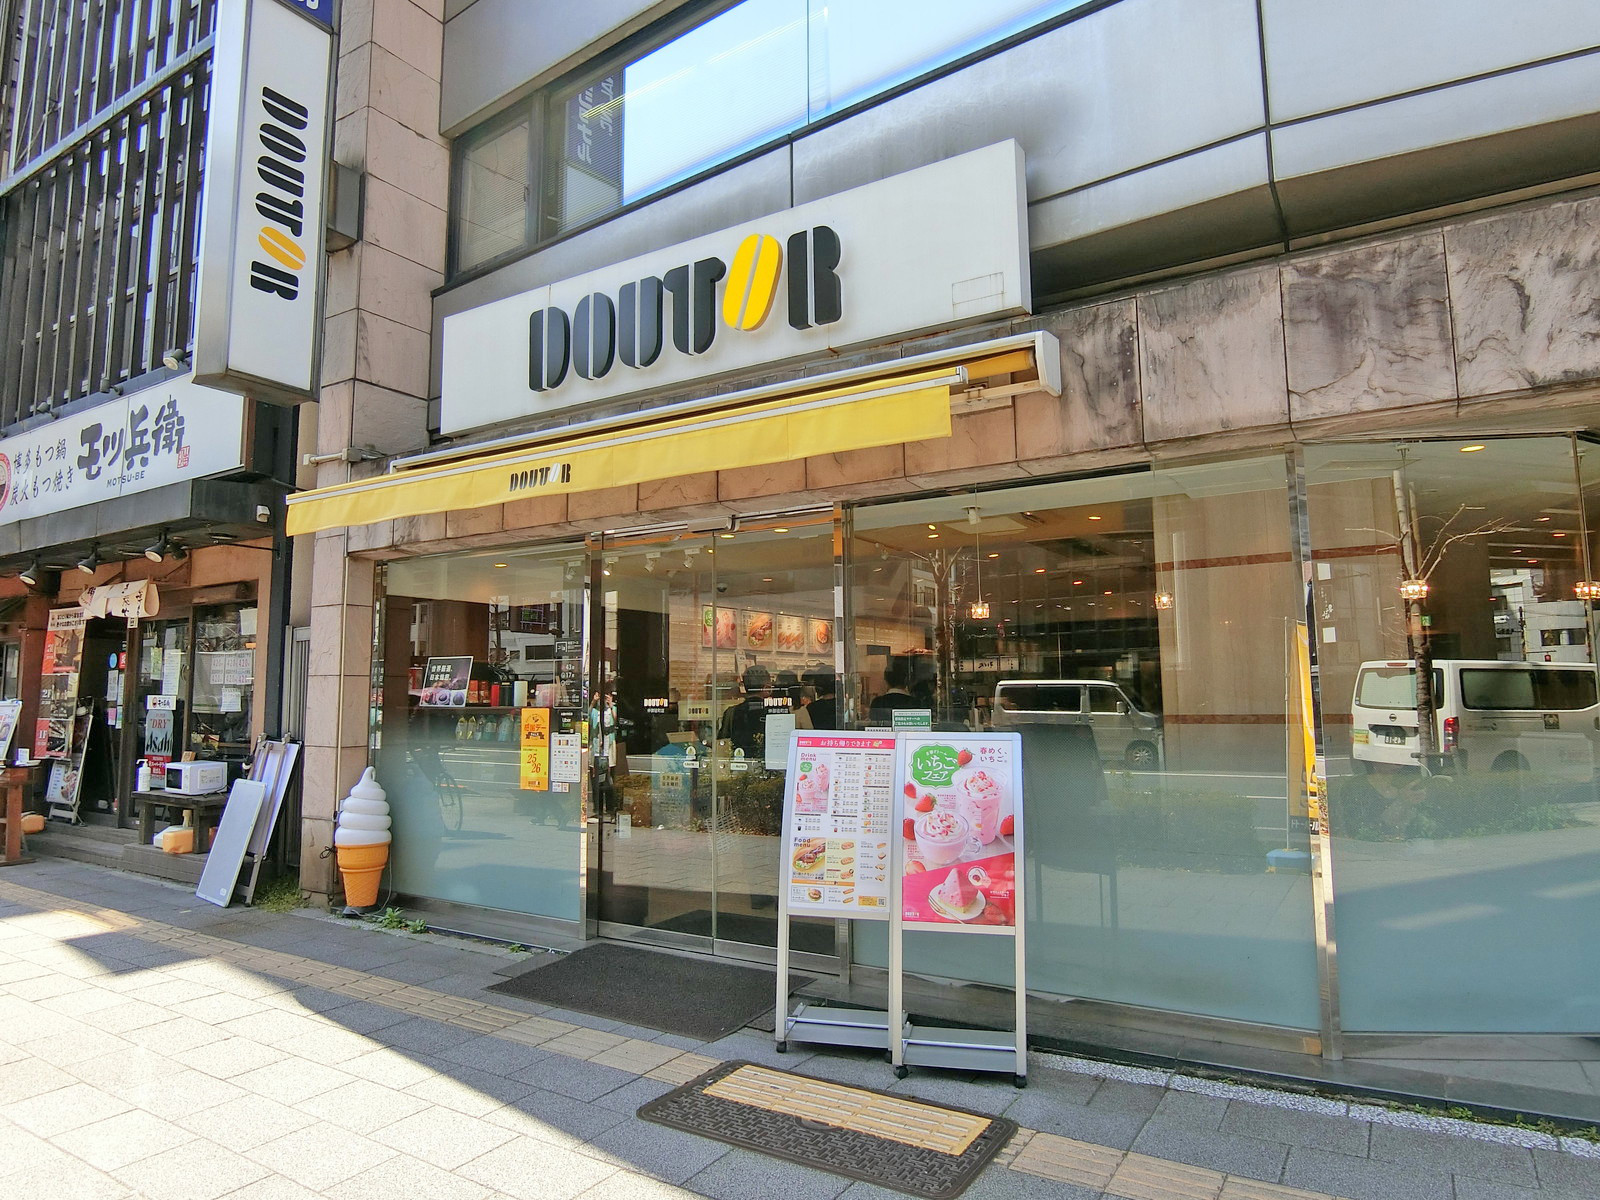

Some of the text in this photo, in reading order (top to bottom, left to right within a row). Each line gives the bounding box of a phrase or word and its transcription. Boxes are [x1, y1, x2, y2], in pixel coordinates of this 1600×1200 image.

[250, 86, 308, 300] DOUTOR
[528, 225, 842, 392] DOUTOR
[14, 439, 67, 474] 博多もつ鍋
[509, 462, 571, 491] DOUTOR
[917, 755, 957, 771] いちご
[921, 770, 949, 781] フェア
